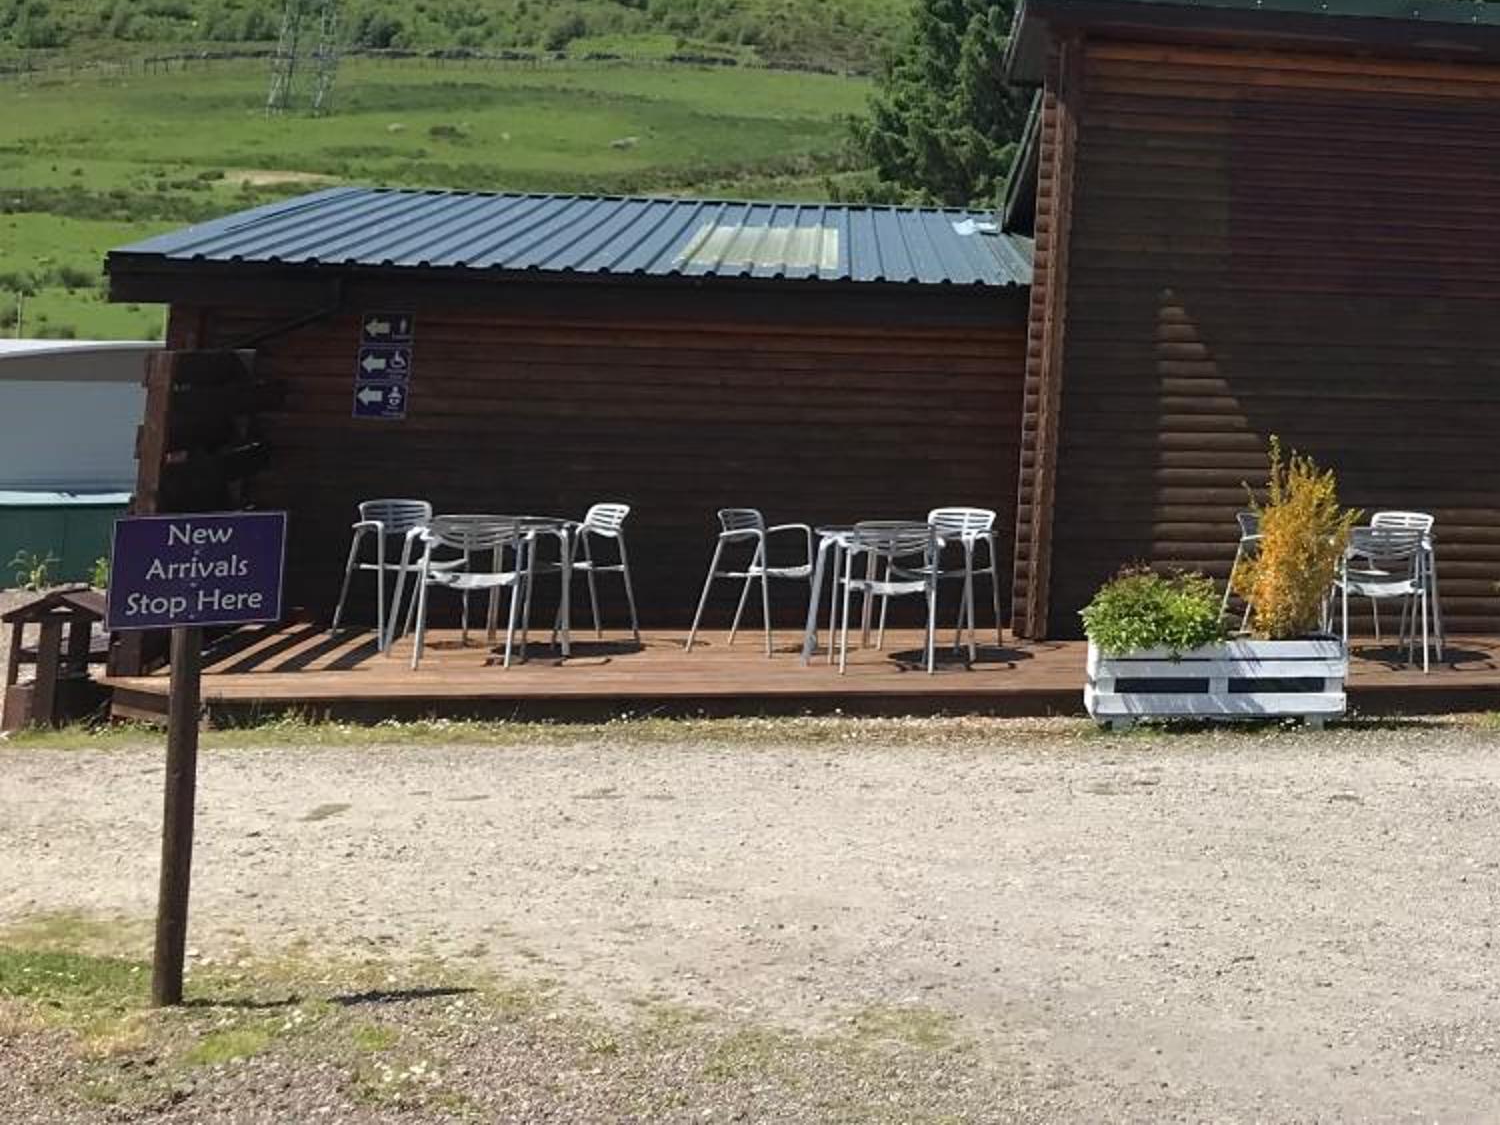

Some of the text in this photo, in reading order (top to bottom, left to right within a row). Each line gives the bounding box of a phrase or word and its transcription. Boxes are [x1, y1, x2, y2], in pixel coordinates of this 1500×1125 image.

[167, 524, 233, 546] New
[145, 555, 249, 580] Arrivals
[125, 589, 263, 619] Stop Here
